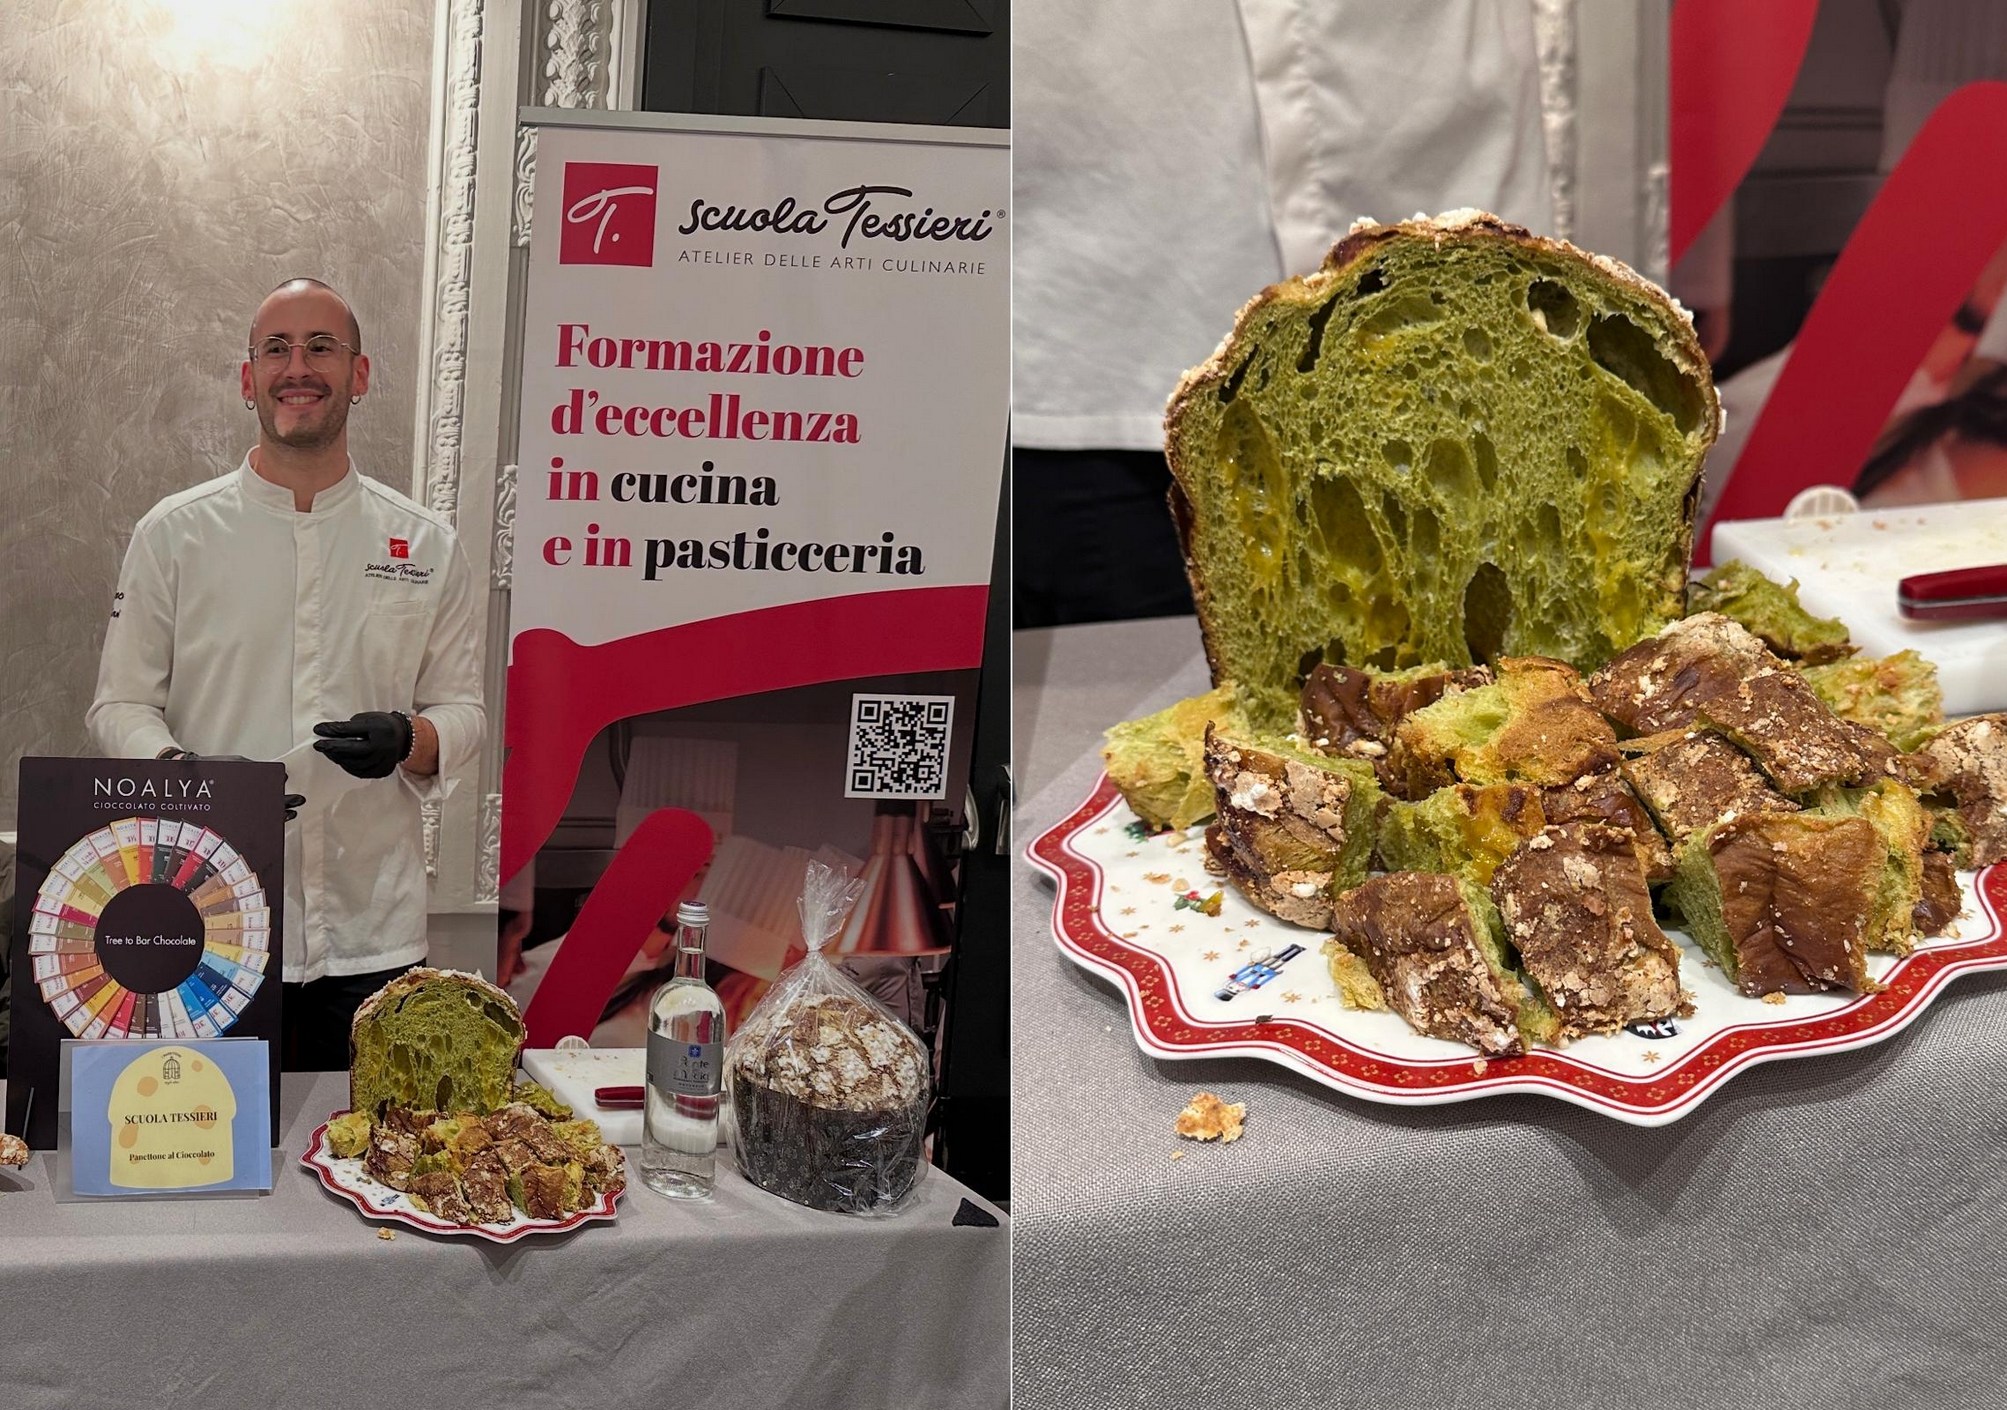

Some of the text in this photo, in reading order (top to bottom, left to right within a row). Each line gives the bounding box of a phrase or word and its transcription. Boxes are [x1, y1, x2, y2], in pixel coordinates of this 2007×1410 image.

[678, 197, 828, 235] scuola
[678, 249, 986, 275] ATELIER DELLE ARTI CULINARIE
[554, 323, 865, 378] Formazione
[550, 388, 862, 444] d’eccellenza
[546, 456, 780, 507] in cucina
[542, 523, 926, 582] e in pasticceria
[93, 777, 212, 799] NOALYA
[93, 801, 211, 812] CIOCCOLATO COLTIVATO
[105, 934, 197, 946] Tree to Bar Chocolate
[124, 1111, 218, 1125] SCUOLA TESSIERI
[129, 1150, 215, 1162] Panettone al Cioccolato
